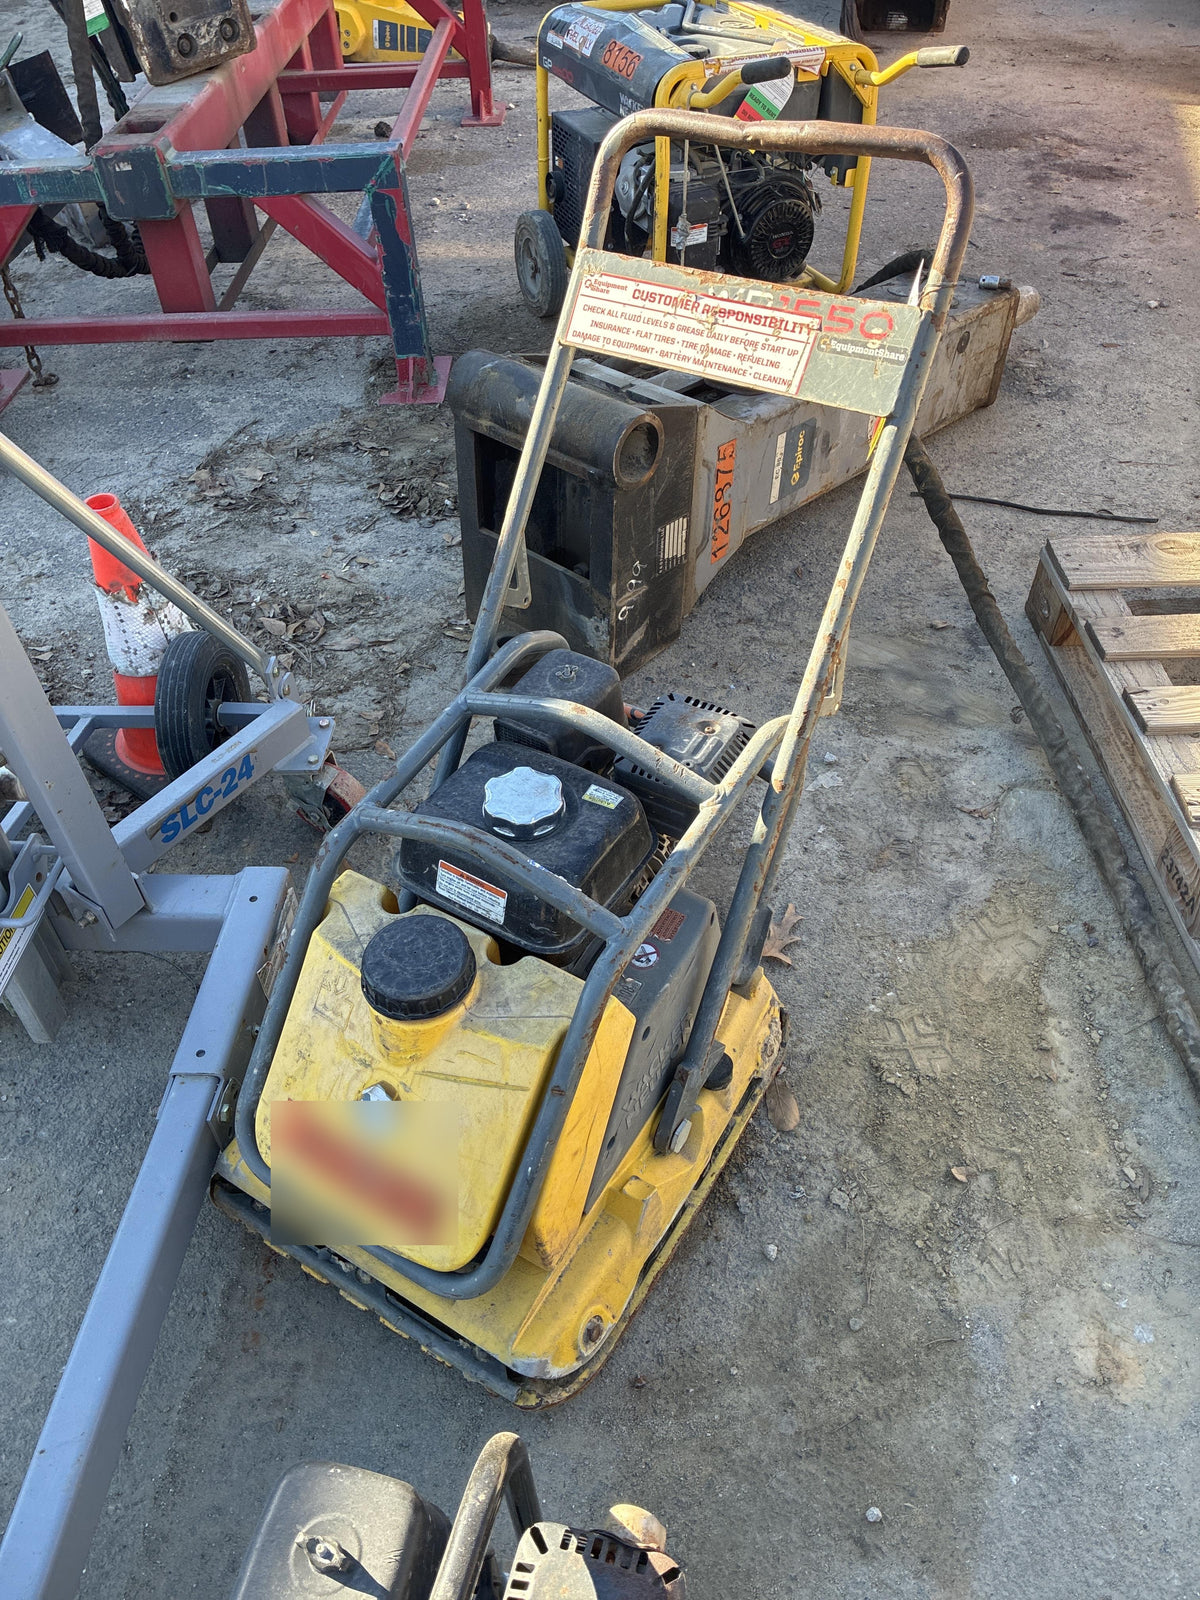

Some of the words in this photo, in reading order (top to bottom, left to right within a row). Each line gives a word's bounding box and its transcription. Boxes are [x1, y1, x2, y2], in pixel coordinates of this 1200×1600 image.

[602, 41, 641, 79] 8156
[772, 230, 794, 239] HONDA
[591, 285, 610, 295] Share
[593, 278, 628, 291] Equipment
[582, 303, 606, 316] CHECK
[606, 308, 619, 319] ALL
[620, 311, 642, 323] FLUID
[642, 316, 668, 330] LEVELS
[669, 321, 675, 331] &
[676, 323, 705, 338] GREASE
[706, 330, 729, 343] DAILY
[729, 335, 760, 350] BEFORE
[760, 342, 787, 356] START
[786, 348, 799, 357] UP
[632, 288, 701, 313] CUSTOMER
[701, 303, 812, 336] RESPONSIBILITY
[571, 329, 601, 343] DAMAGE
[602, 336, 612, 346] TO
[611, 338, 655, 355] EQUIPMENT
[658, 349, 691, 364] BATTERY
[692, 355, 748, 378] MAINTENANCE
[752, 372, 793, 388] CLEANING
[590, 319, 631, 336] INSURANCE
[635, 330, 653, 341] FLAT
[653, 333, 676, 346] TIRES
[681, 339, 699, 351] TIRE
[699, 344, 734, 359] DAMAGE
[736, 353, 781, 370] REFUELING
[830, 338, 906, 362] EquipmentShare
[793, 429, 806, 472] Epiroc
[160, 753, 255, 844] SLC-24
